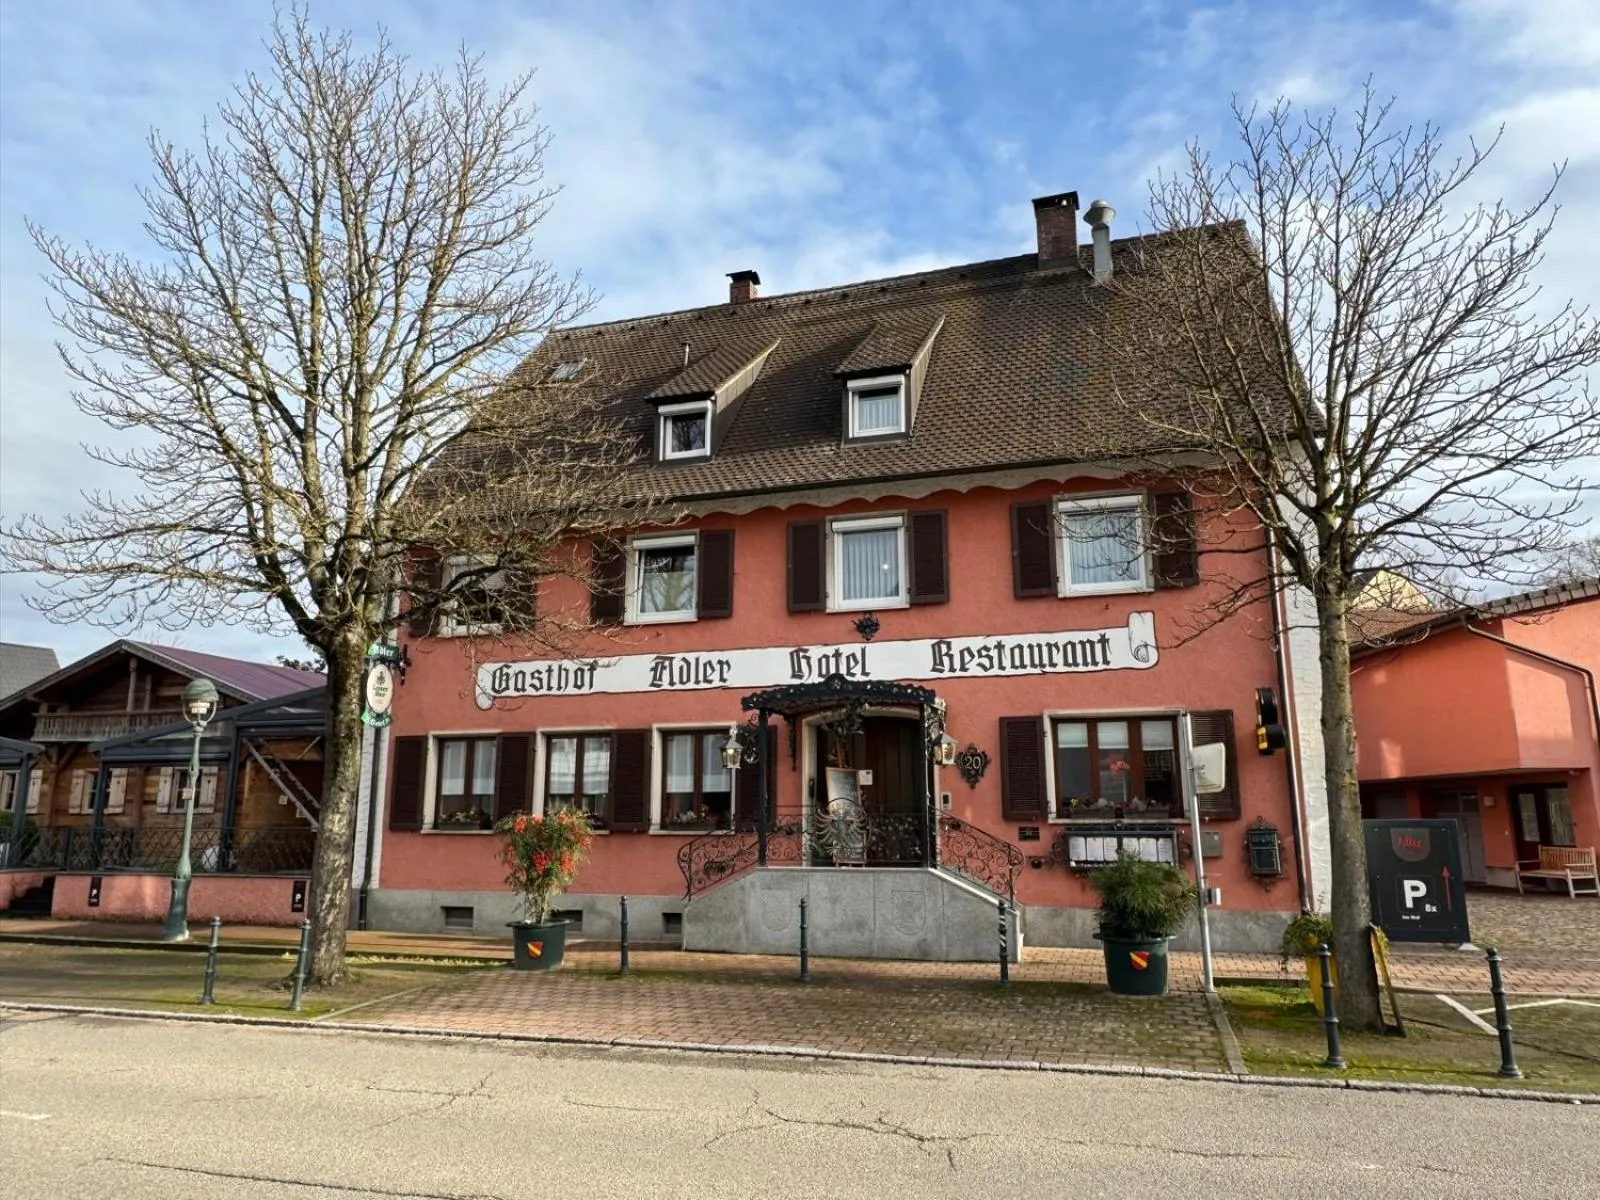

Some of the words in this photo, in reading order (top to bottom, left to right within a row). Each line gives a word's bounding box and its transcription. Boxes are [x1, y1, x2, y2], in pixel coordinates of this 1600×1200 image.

[491, 661, 597, 694] Gasthof
[650, 655, 731, 688] Adler
[789, 645, 871, 682] Hotel
[930, 632, 1110, 674] Restaurant
[964, 755, 981, 769] 20
[295, 893, 302, 903] P
[1403, 880, 1427, 908] P
